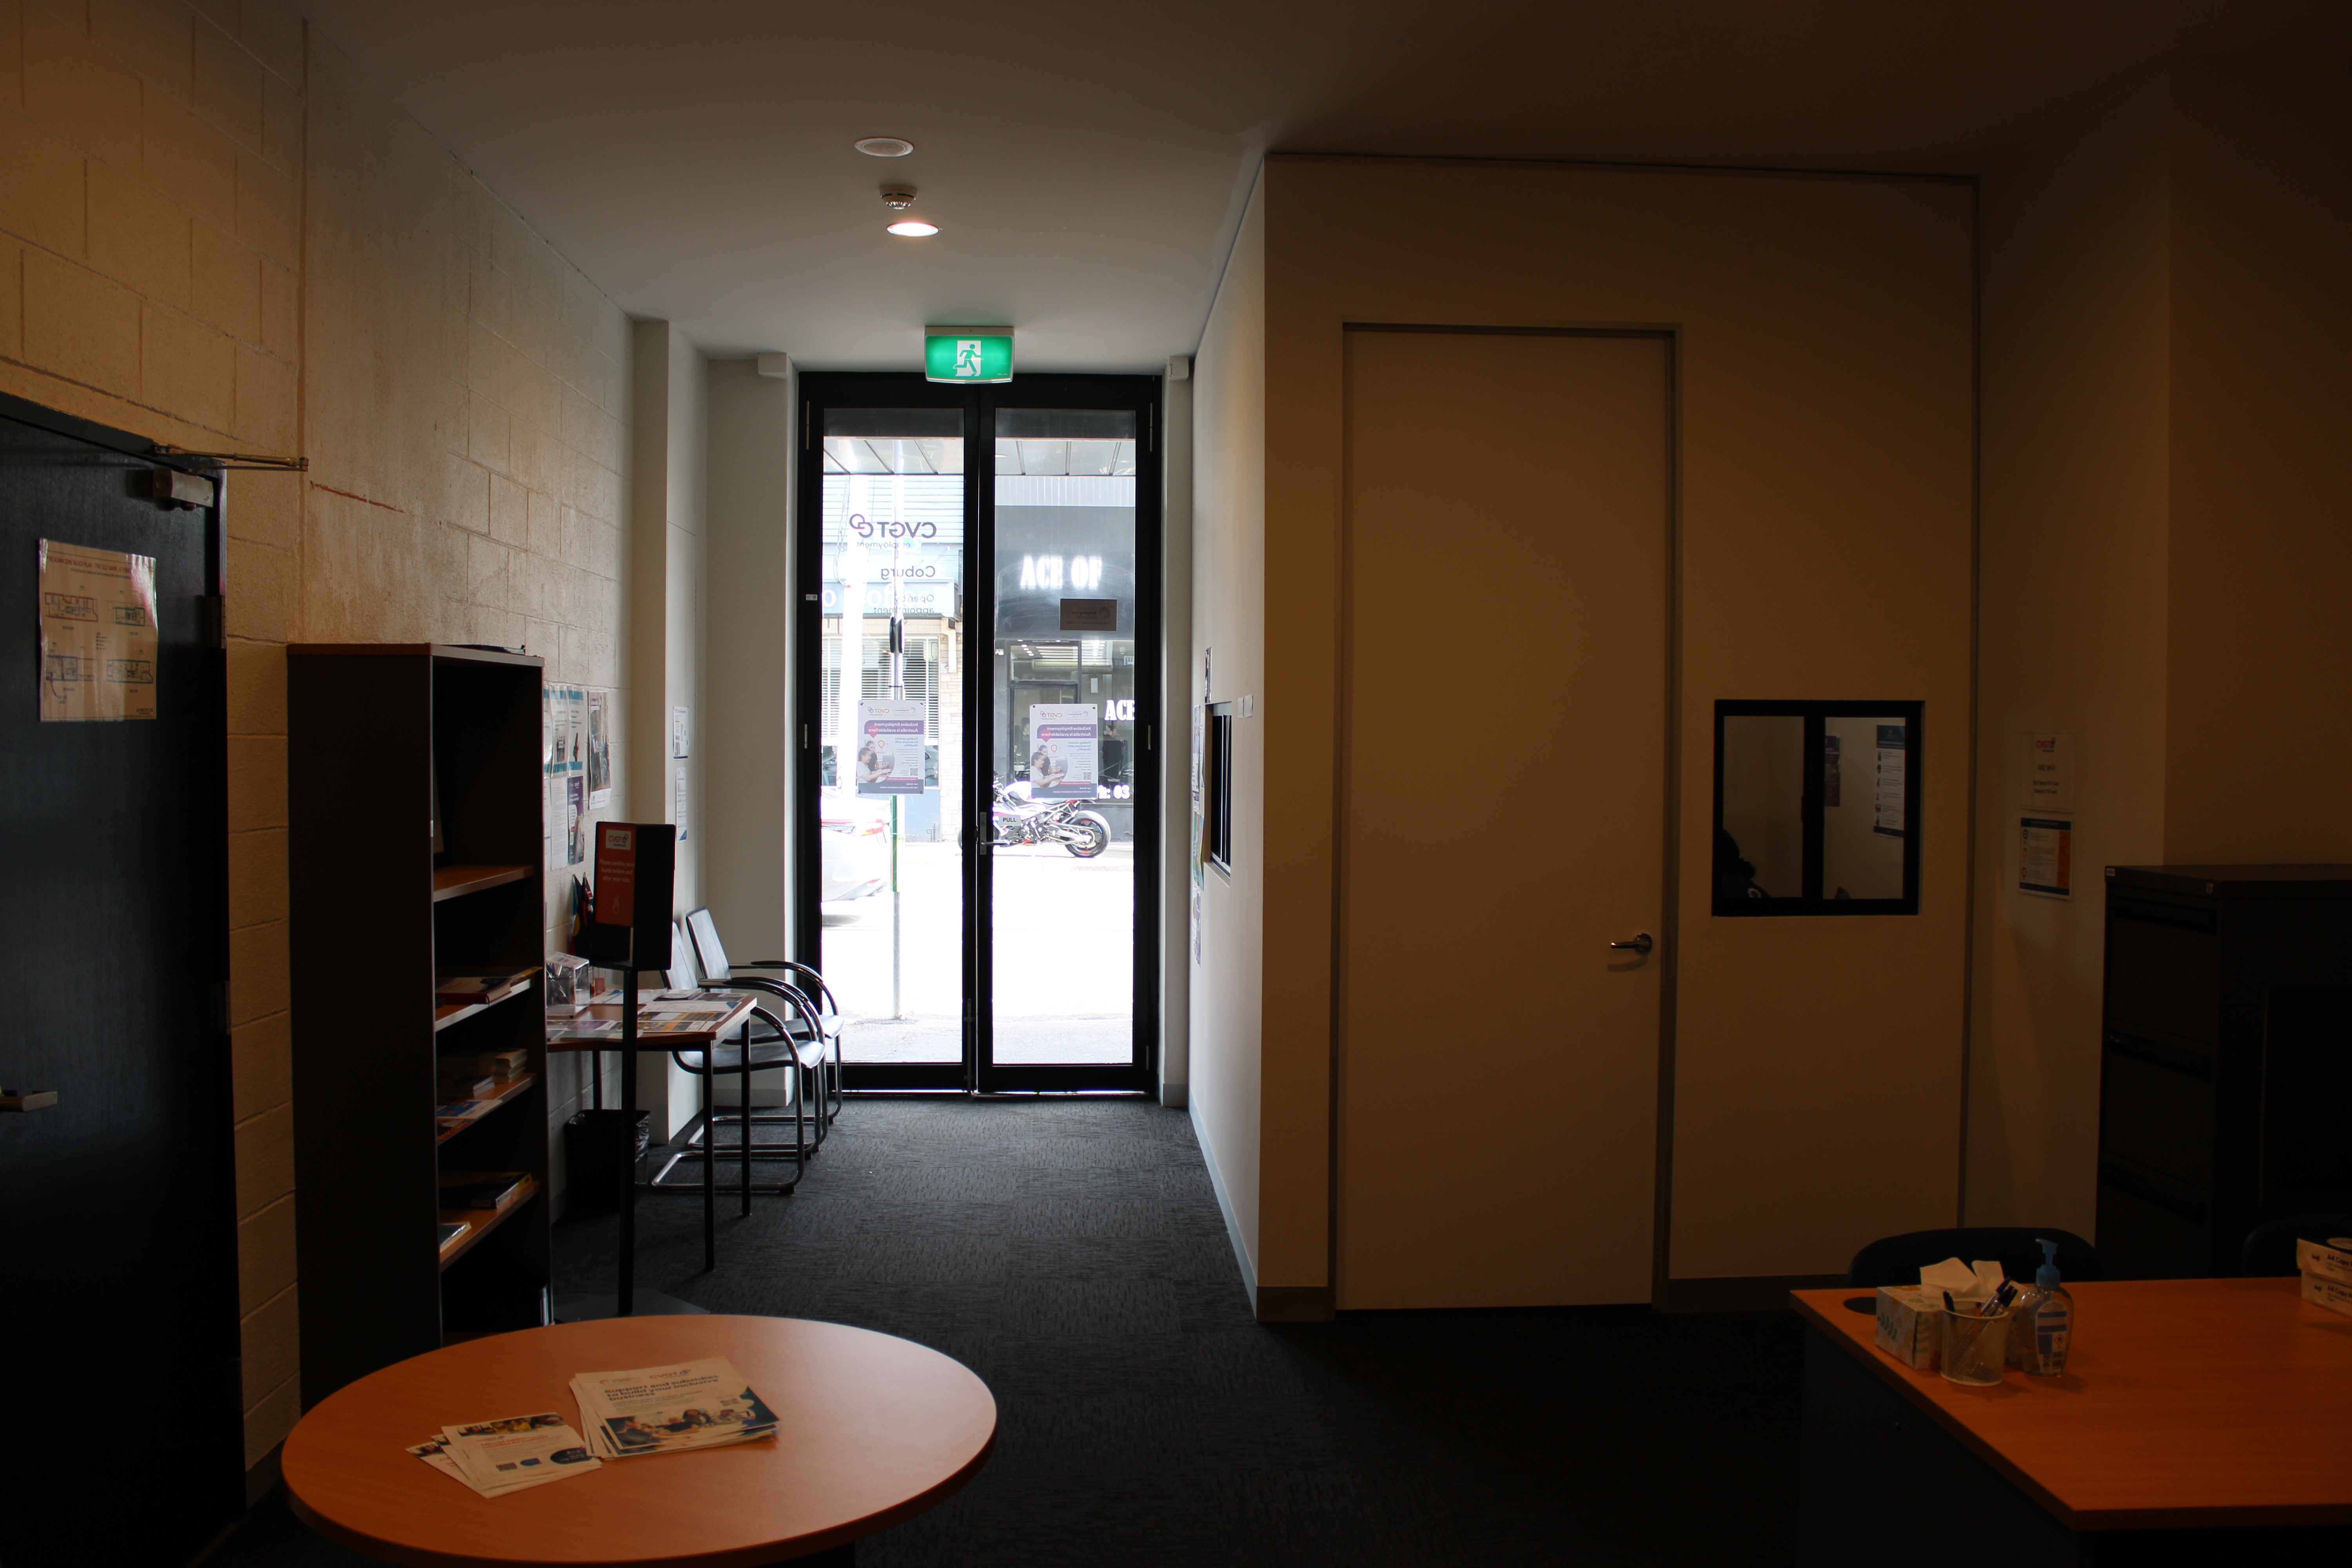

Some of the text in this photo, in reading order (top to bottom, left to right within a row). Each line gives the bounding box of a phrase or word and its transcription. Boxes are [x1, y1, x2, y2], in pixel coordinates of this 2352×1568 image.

[1020, 554, 1102, 590] ACE OF
[1105, 700, 1135, 720] ACE
[1114, 785, 1130, 799] 03
[671, 1375, 719, 1385] subsidies
[673, 1378, 719, 1389] inclusive
[609, 1392, 655, 1401] business
